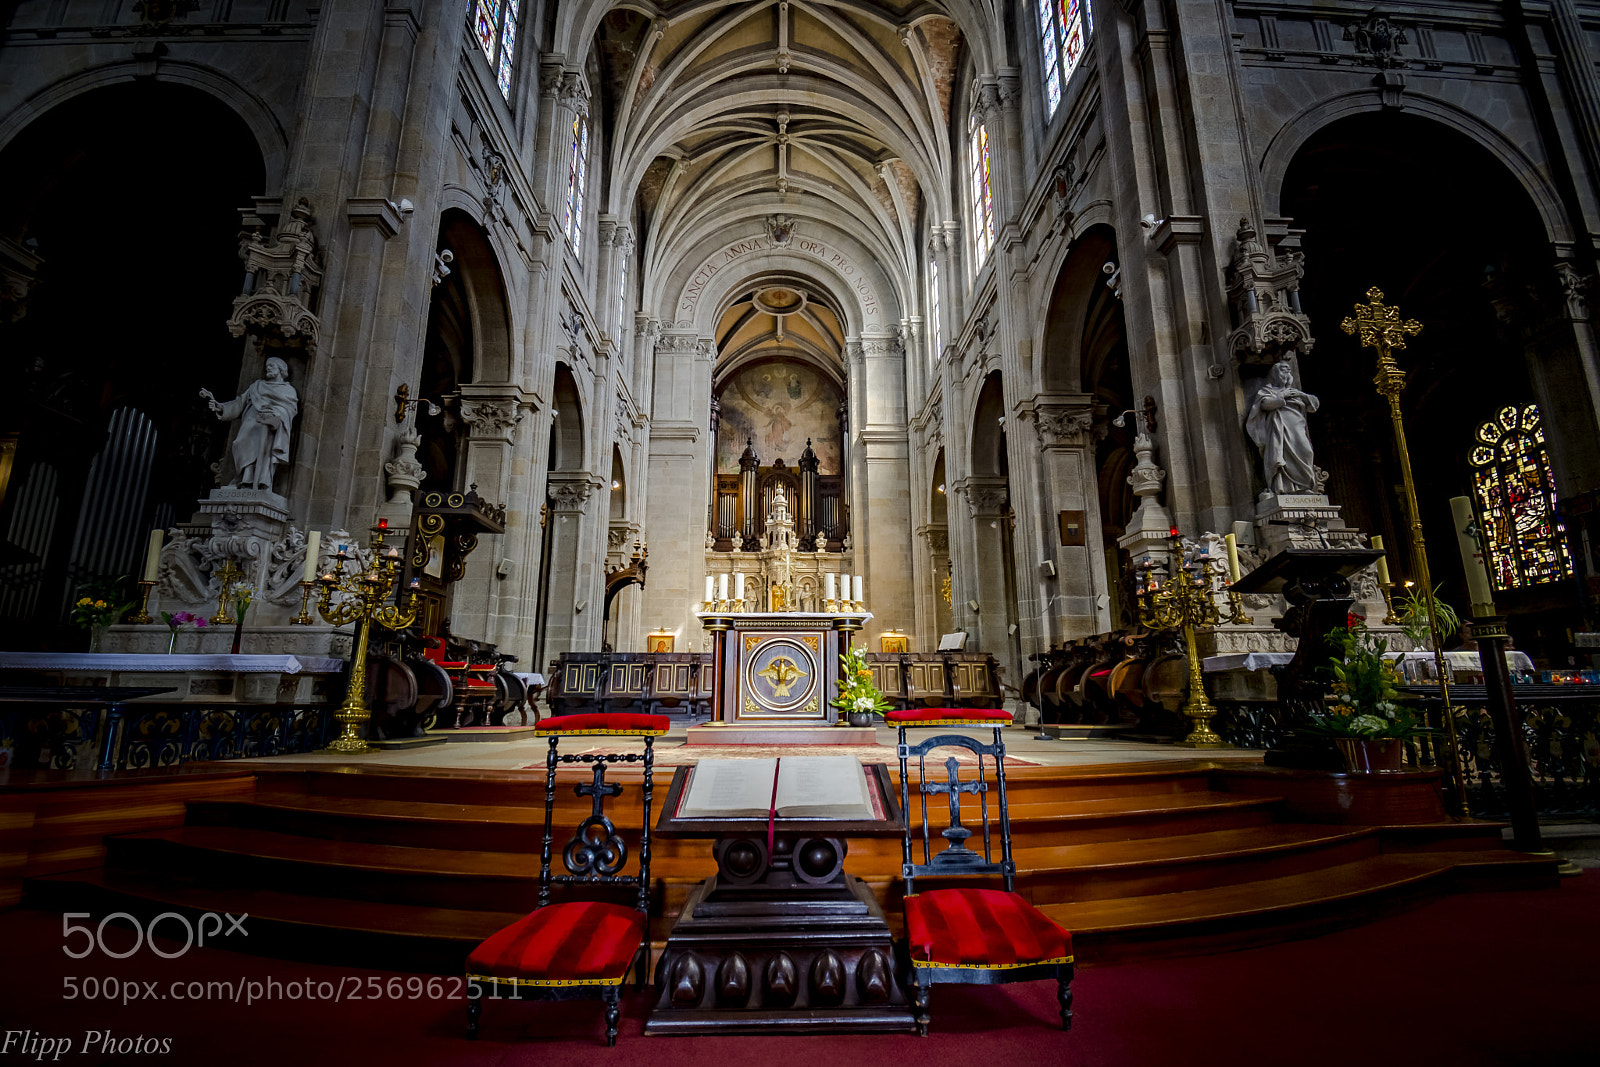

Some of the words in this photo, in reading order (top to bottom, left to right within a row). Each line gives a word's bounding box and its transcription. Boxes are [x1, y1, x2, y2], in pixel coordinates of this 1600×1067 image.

[682, 264, 717, 312] SANCTA
[724, 239, 762, 262] ANNA
[800, 241, 826, 258] ORA
[830, 253, 854, 275] PRO
[853, 277, 879, 316] NOBIS
